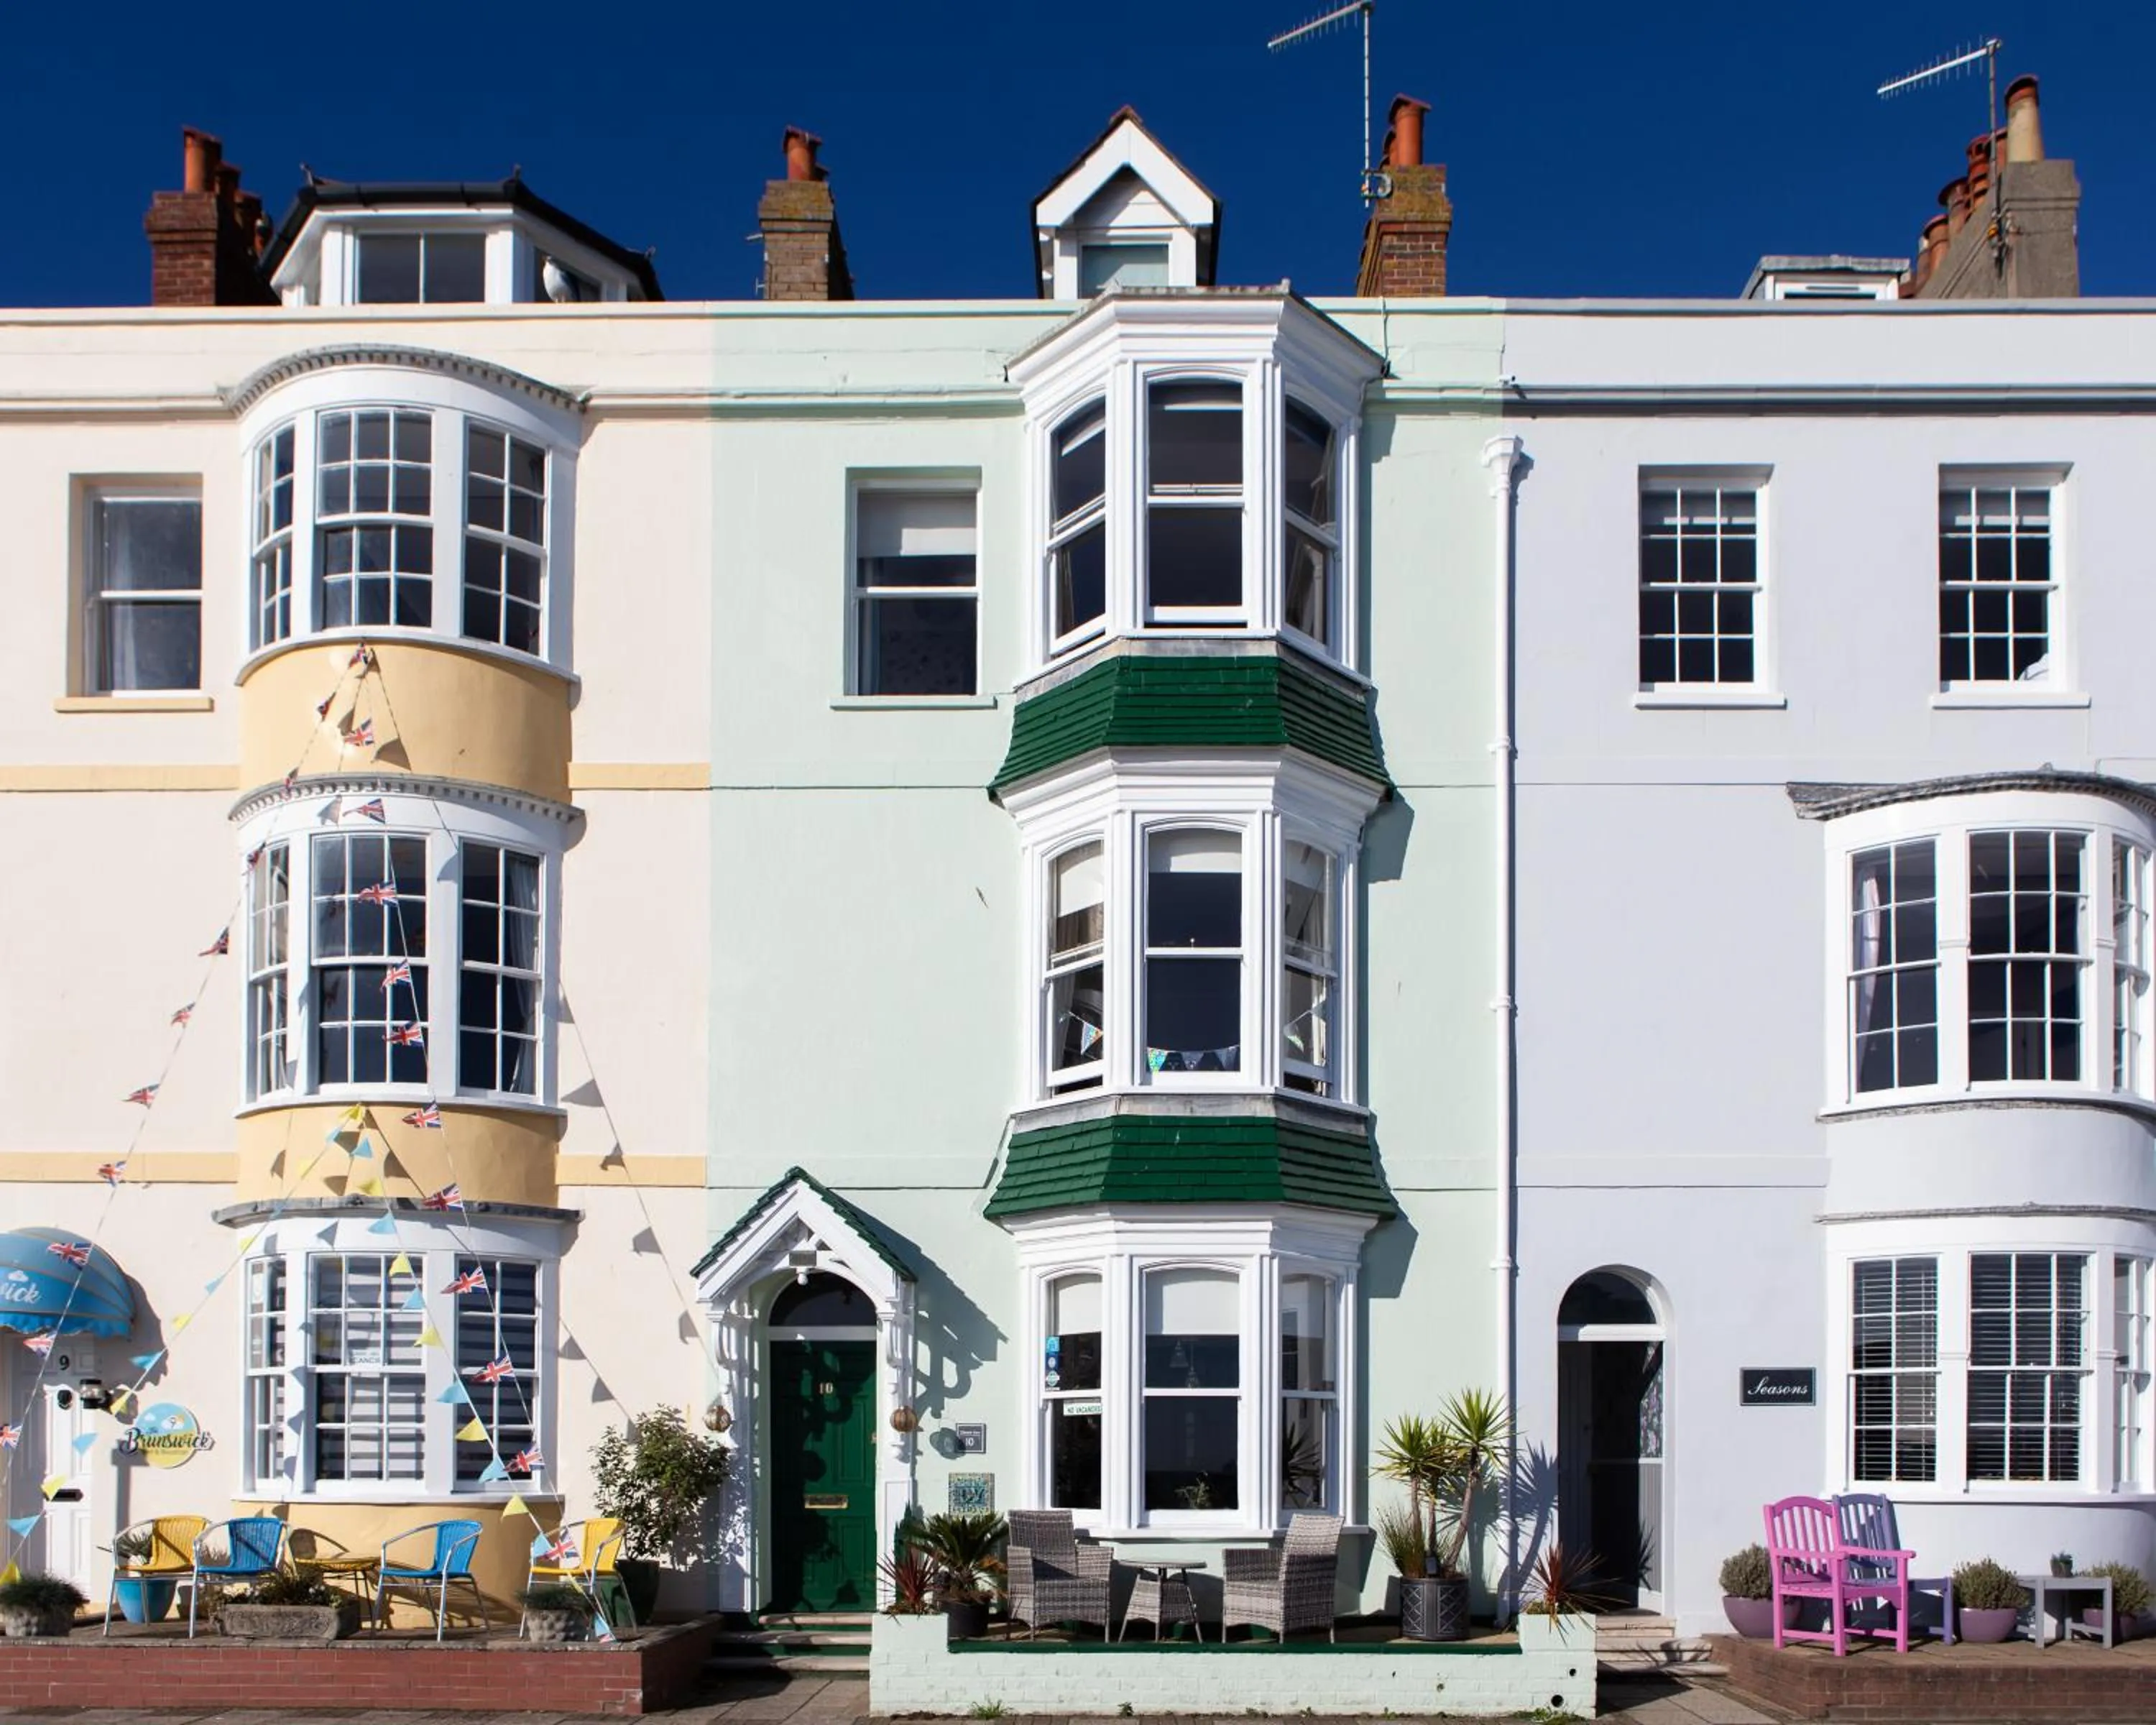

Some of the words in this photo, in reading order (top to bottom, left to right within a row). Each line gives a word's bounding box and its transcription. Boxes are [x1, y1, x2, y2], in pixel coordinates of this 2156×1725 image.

[59, 1355, 70, 1371] 9
[819, 1382, 833, 1394] 10
[1747, 1376, 1808, 1395] Seasons
[119, 1427, 211, 1455] Brunswick
[965, 1438, 975, 1447] 10
